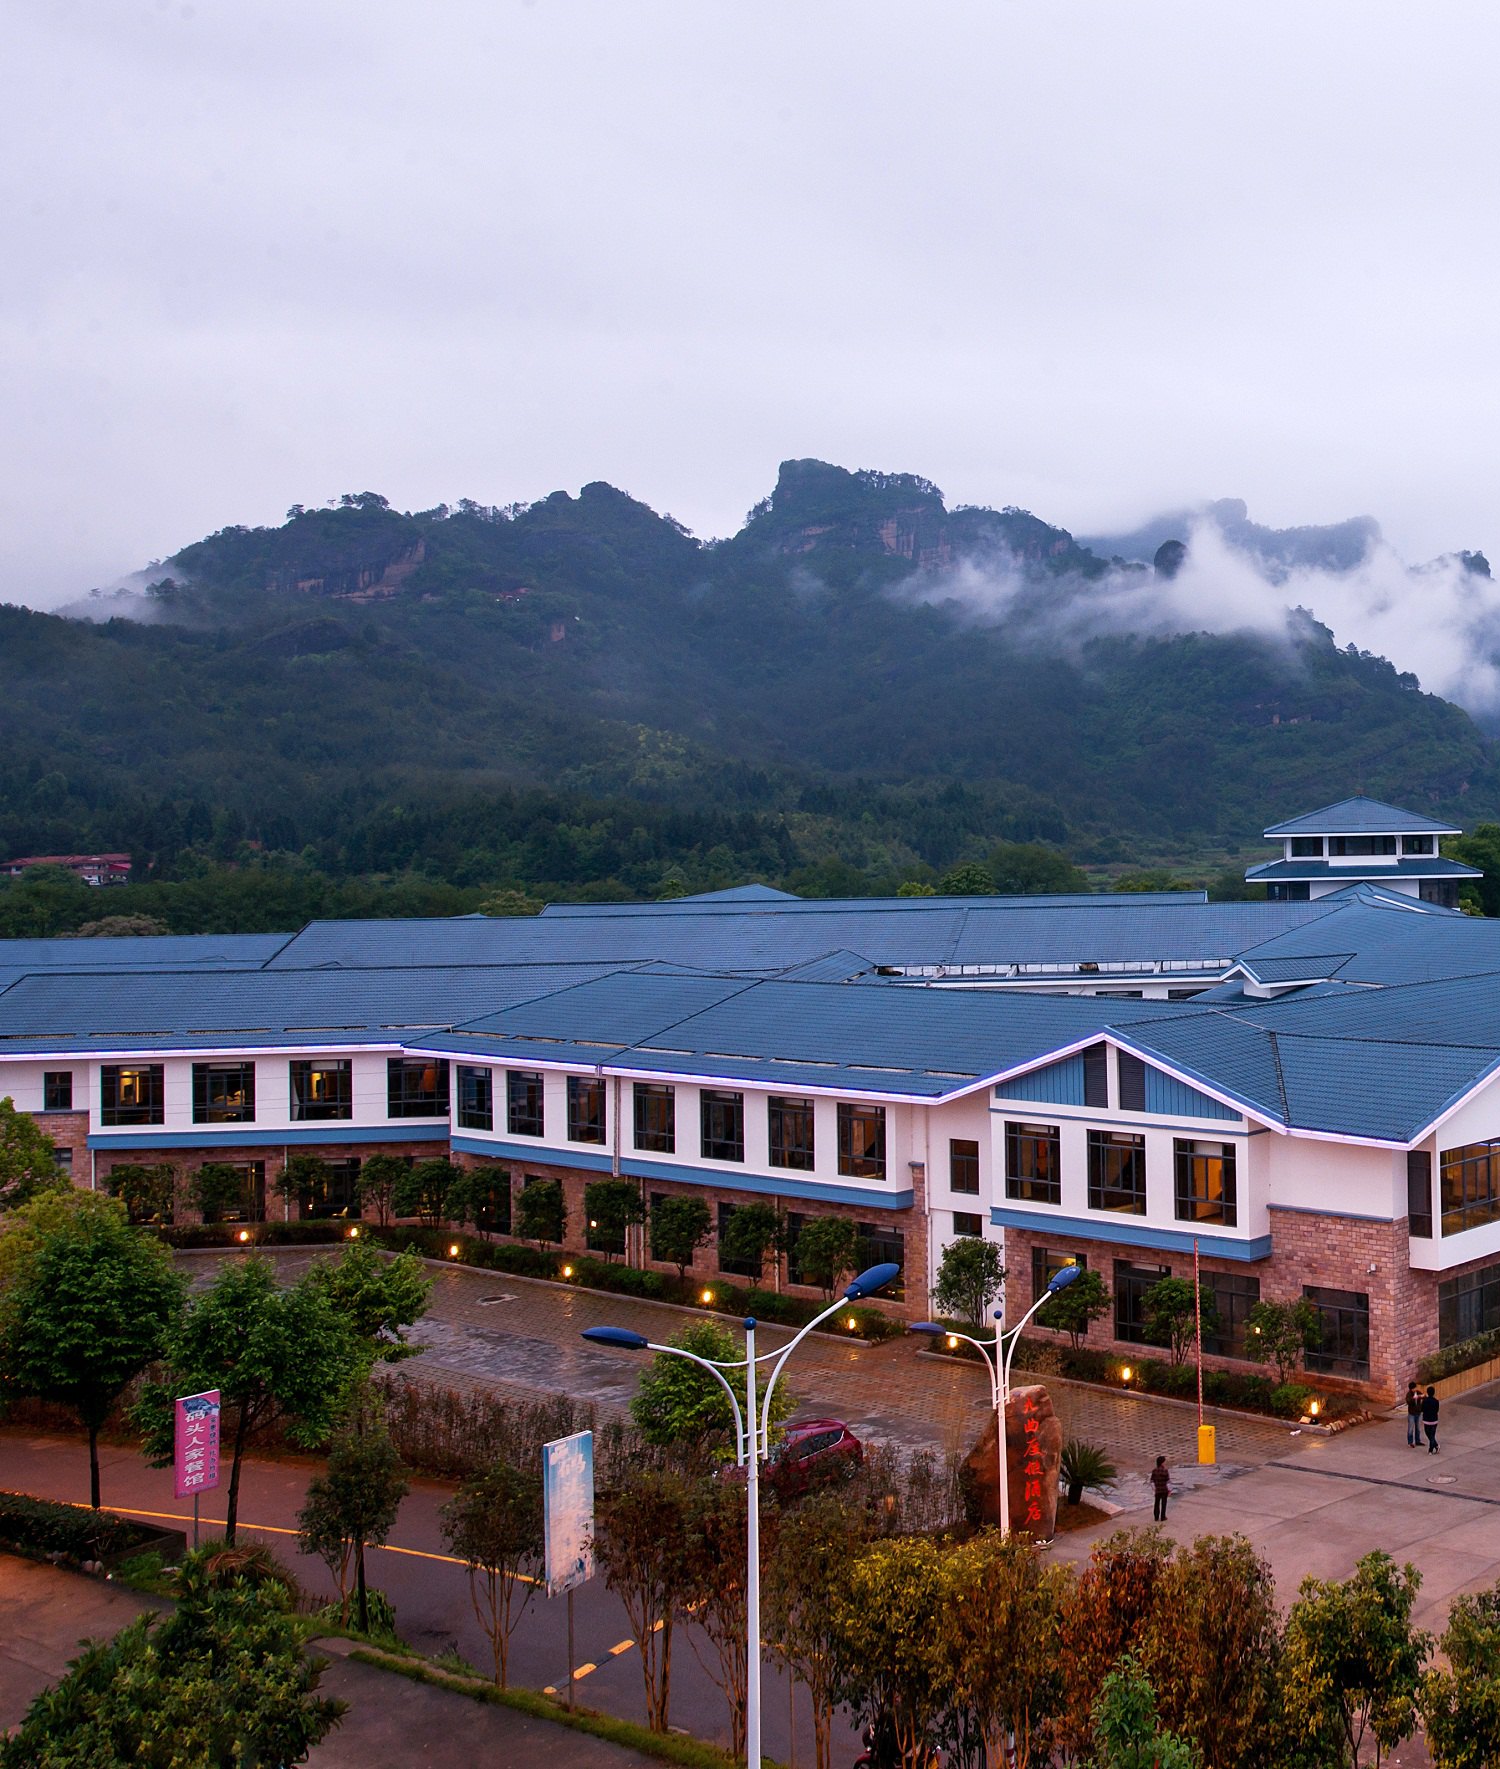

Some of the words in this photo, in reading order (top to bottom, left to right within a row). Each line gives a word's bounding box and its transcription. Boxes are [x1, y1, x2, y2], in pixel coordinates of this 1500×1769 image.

[184, 1410, 205, 1487] 码头人家餐馆
[1024, 1398, 1044, 1525] 九曲度假酒店
